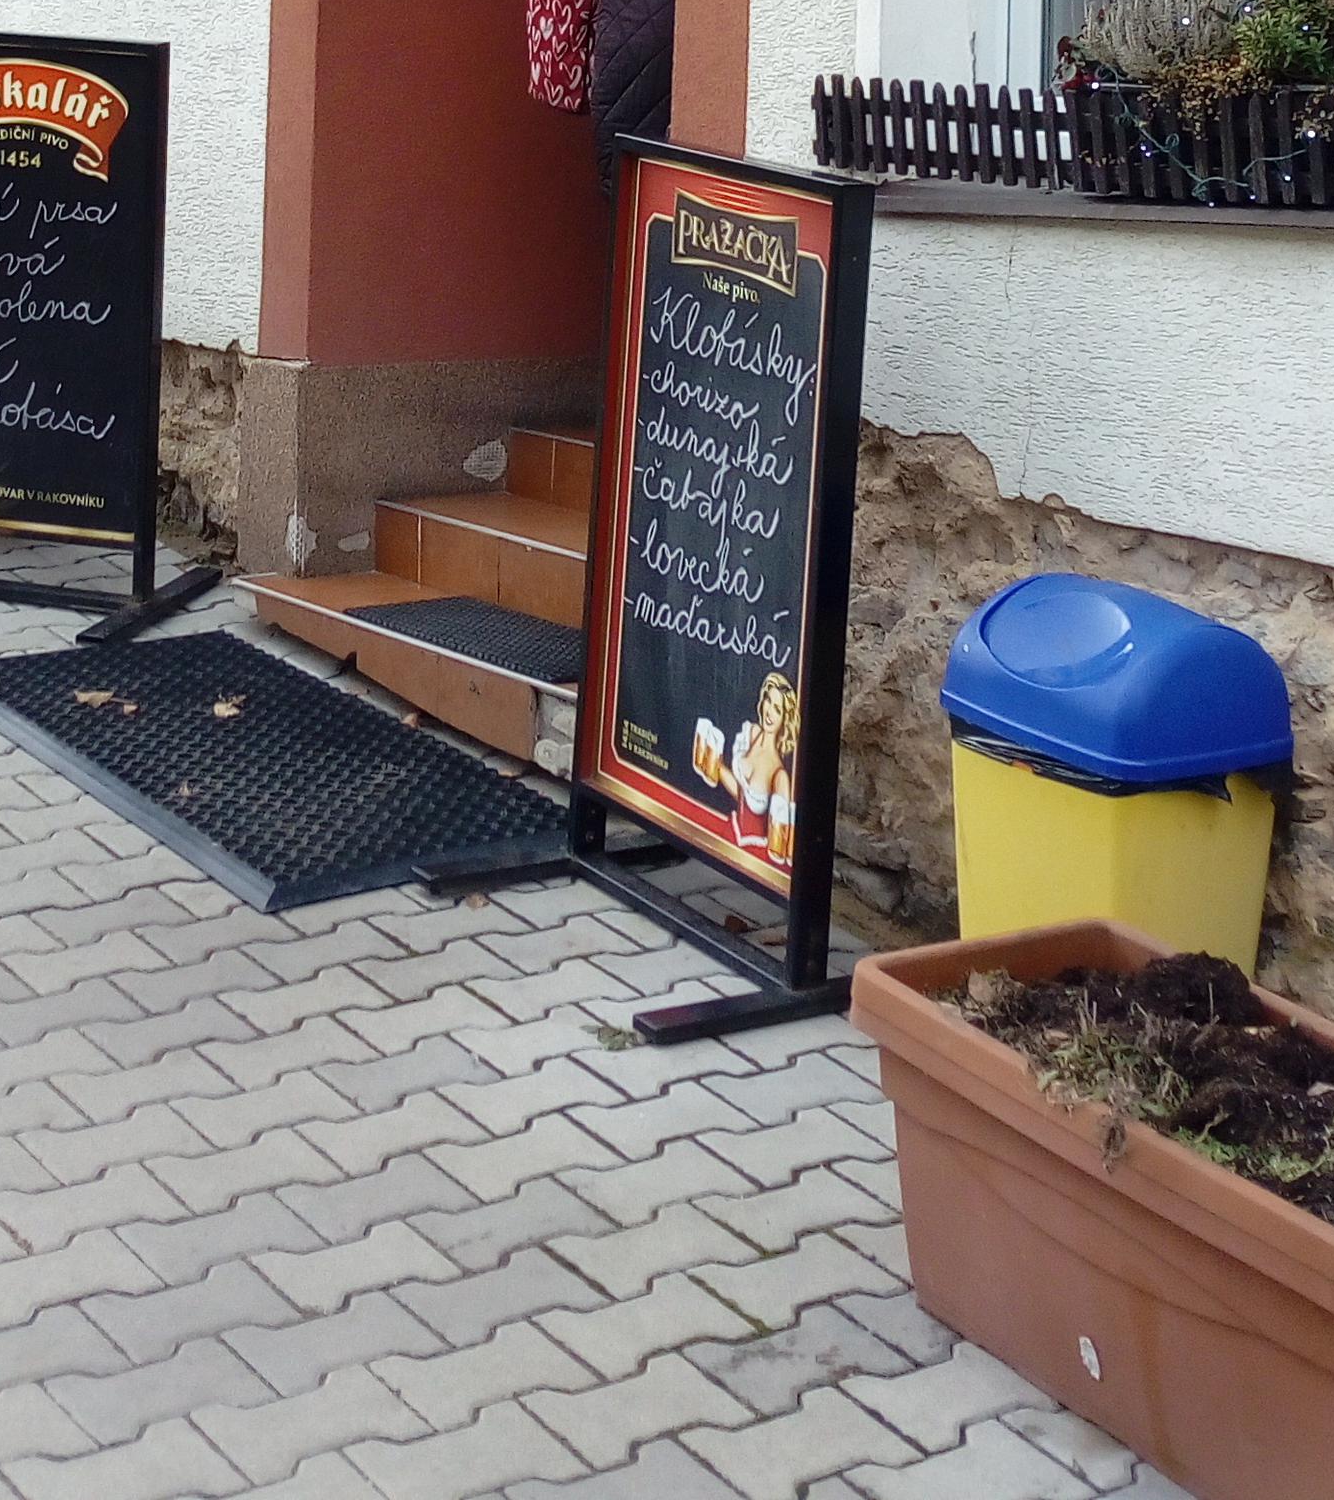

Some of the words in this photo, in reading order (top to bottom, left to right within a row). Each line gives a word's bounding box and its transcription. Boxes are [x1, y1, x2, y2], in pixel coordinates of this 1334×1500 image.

[40, 131, 70, 150] PIVO
[0, 149, 42, 168] 1454
[29, 199, 118, 239] prsa
[678, 208, 792, 285] PRAŽAČKA
[702, 271, 730, 294] Naše
[27, 490, 36, 500] V
[37, 491, 105, 509] RAKOVNÍKU
